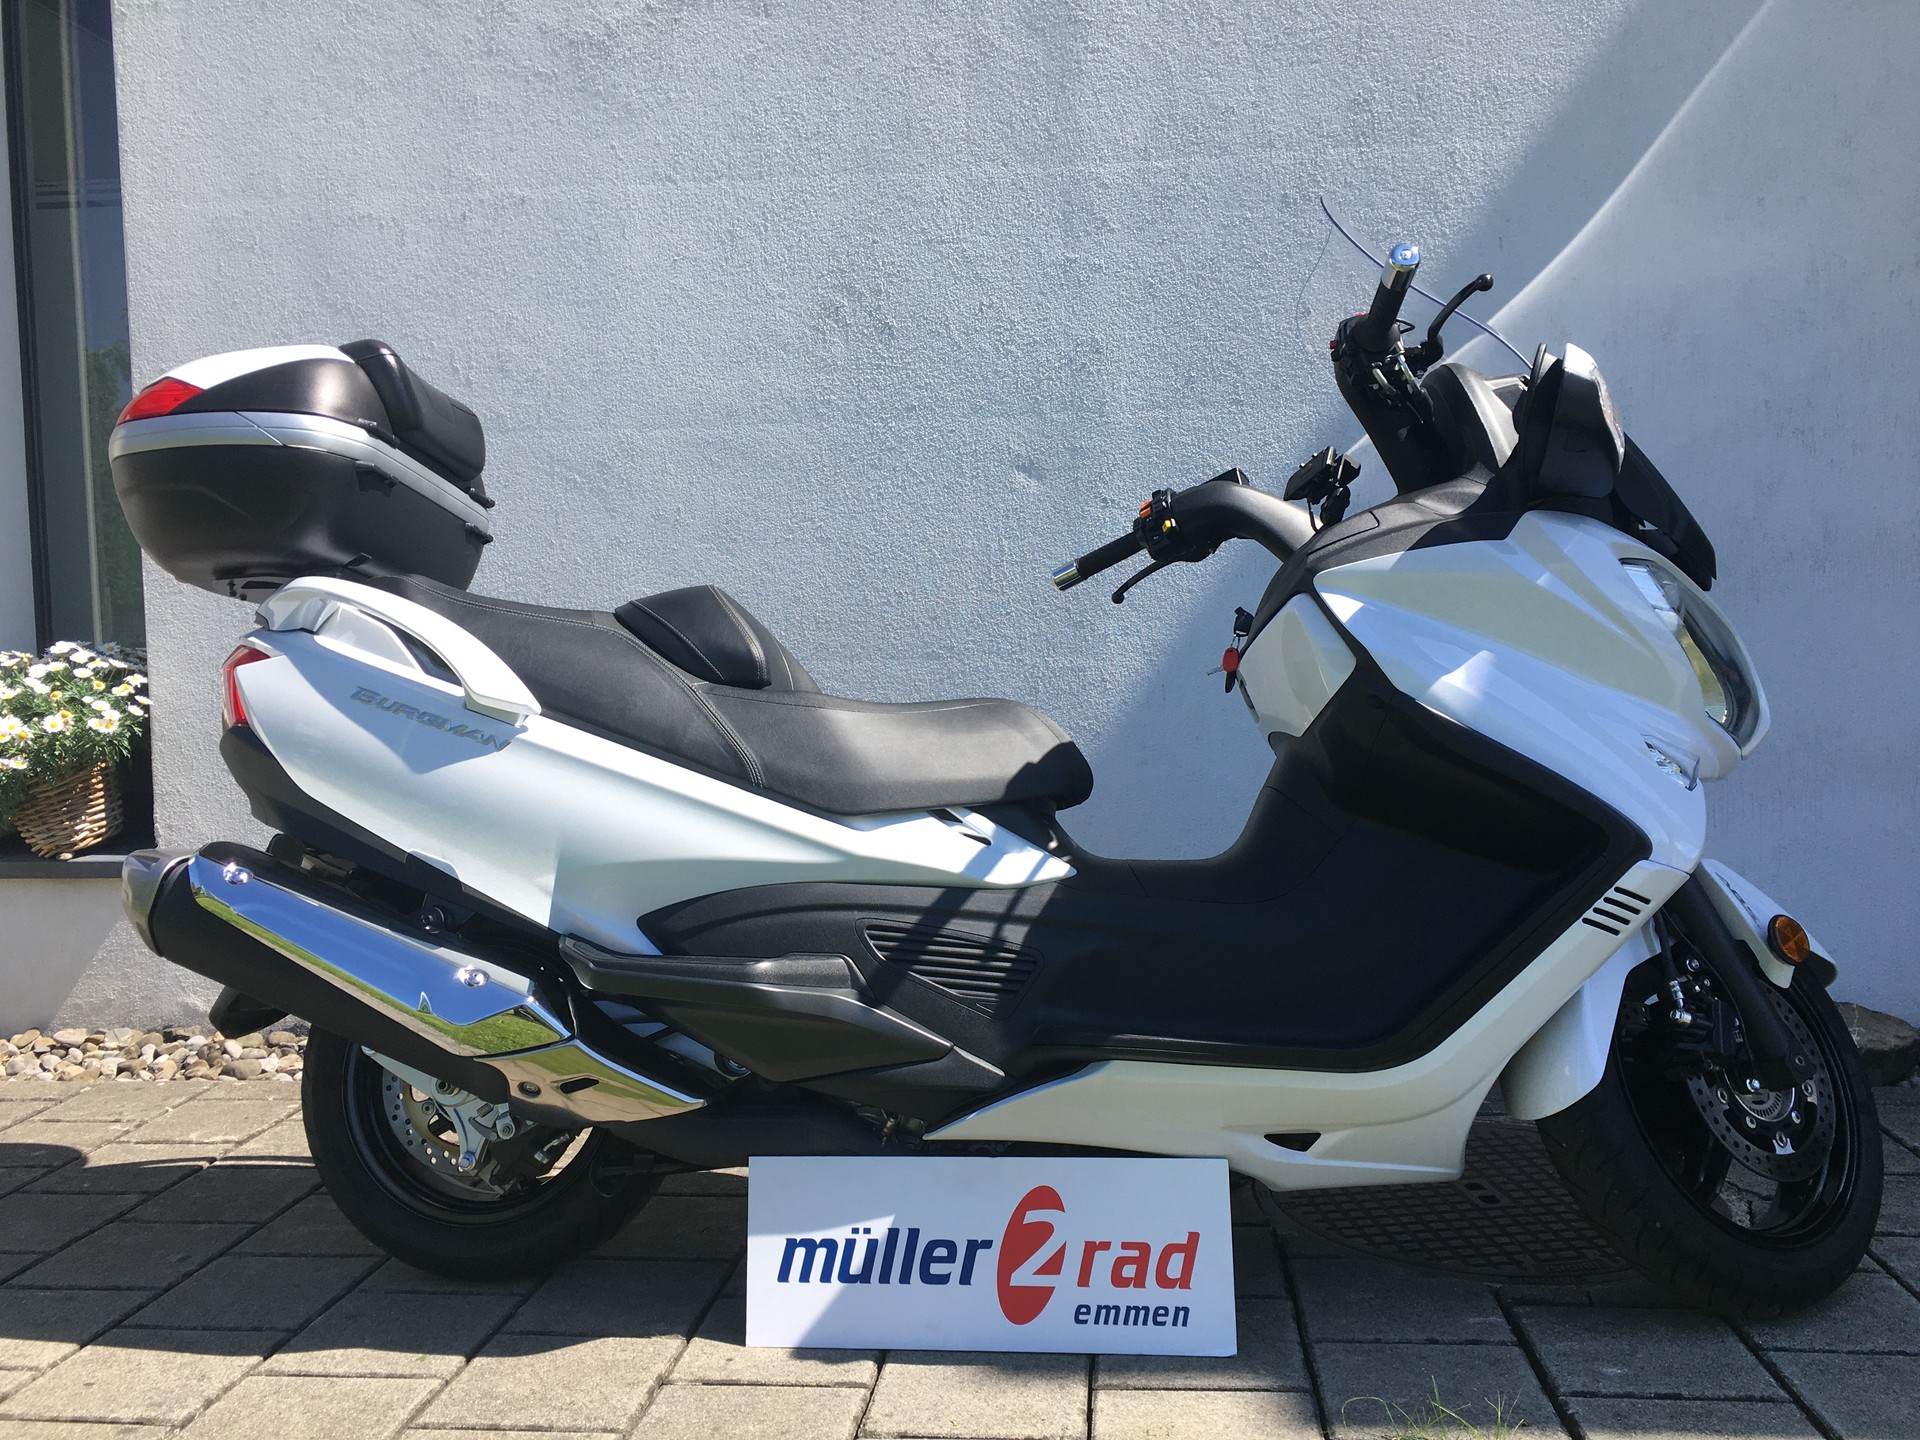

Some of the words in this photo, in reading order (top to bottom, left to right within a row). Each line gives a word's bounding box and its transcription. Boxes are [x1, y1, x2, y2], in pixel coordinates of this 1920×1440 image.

[350, 685, 512, 752] BURGMAN
[778, 1228, 993, 1285] müller
[1078, 1232, 1199, 1288] rad
[1074, 1304, 1190, 1327] emmen
